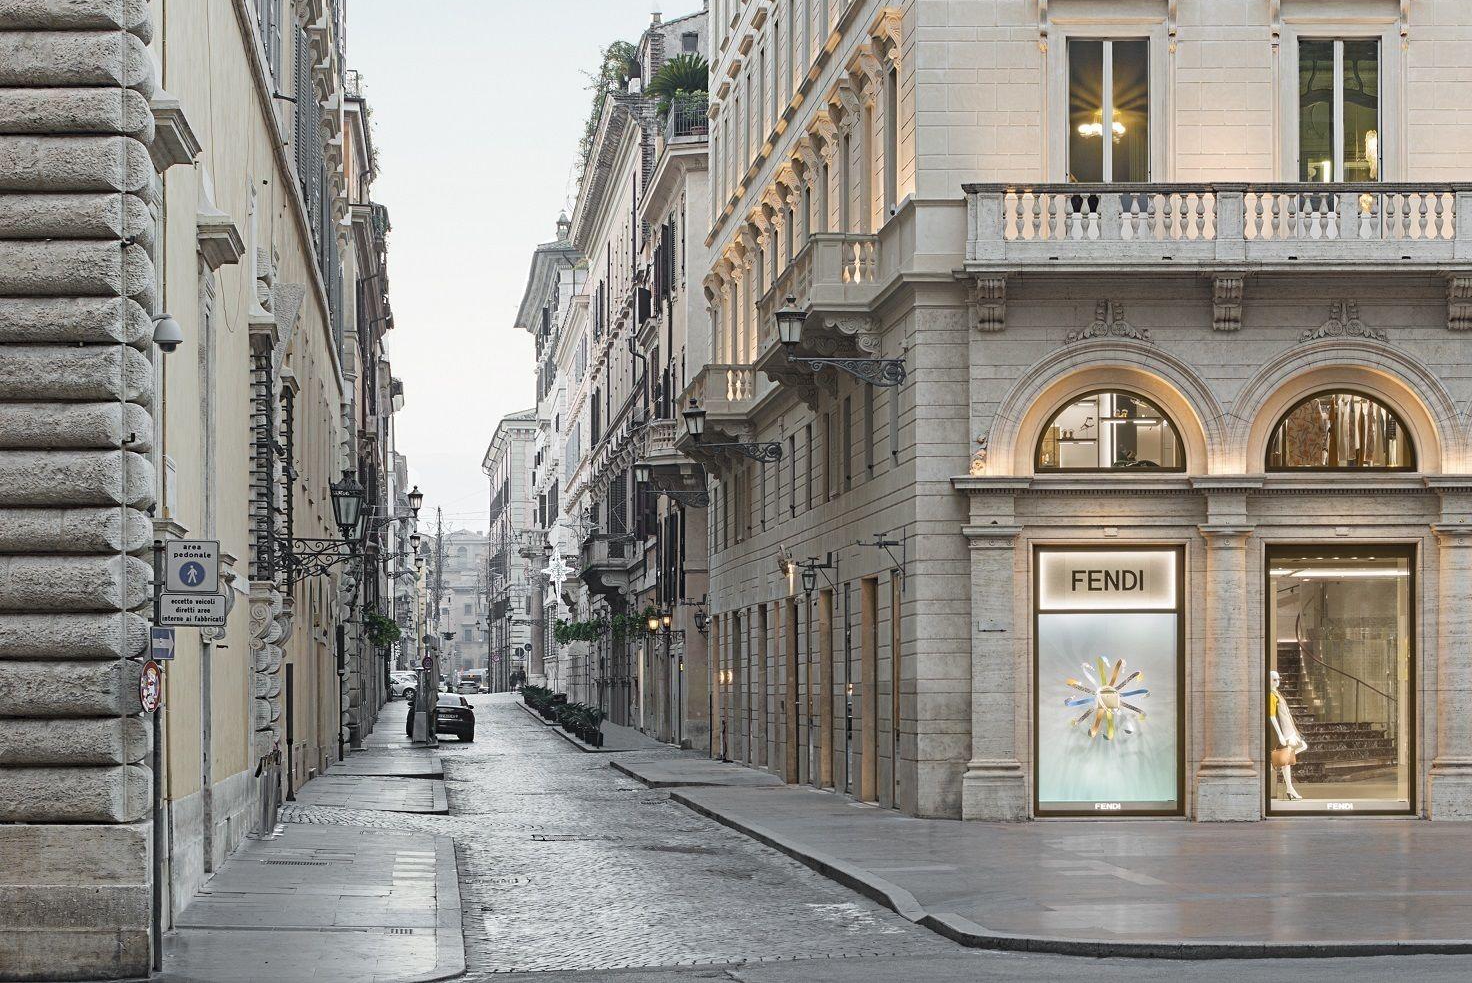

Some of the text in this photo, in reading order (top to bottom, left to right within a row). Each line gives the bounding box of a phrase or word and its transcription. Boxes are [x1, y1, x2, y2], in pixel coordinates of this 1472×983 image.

[1071, 569, 1144, 591] FENDI
[1095, 802, 1121, 810] FENDI
[1326, 802, 1353, 810] FENDI
